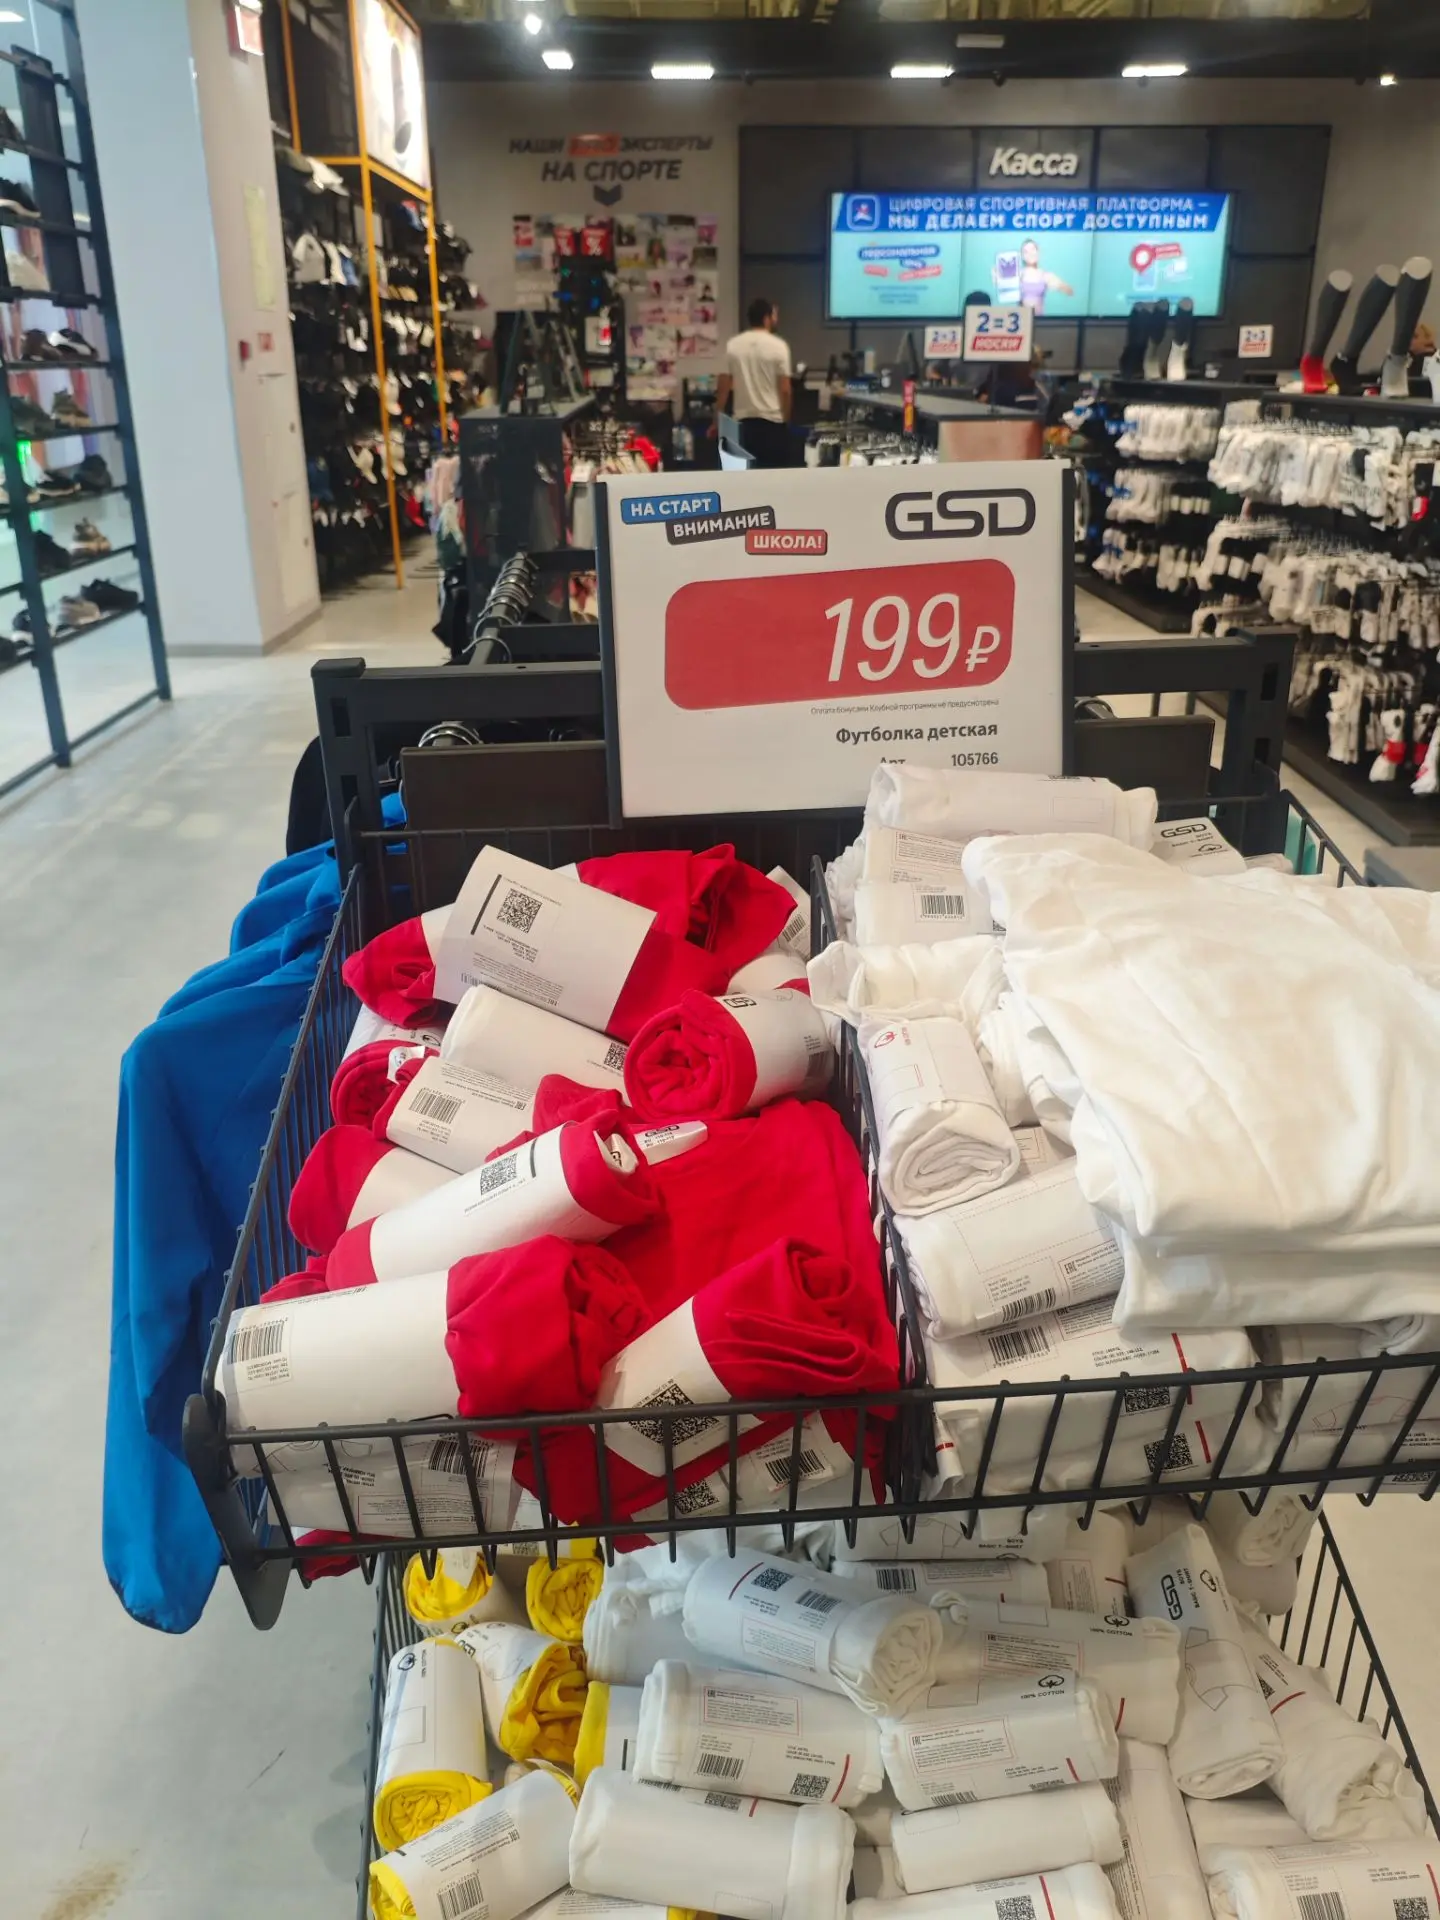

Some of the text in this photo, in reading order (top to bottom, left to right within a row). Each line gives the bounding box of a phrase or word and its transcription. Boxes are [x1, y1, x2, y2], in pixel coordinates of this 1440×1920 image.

[542, 159, 682, 182] НА СПОРТЕ
[989, 147, 1078, 176] Касса
[888, 196, 976, 212] ЦИФРОВАЯ
[979, 196, 1089, 212] СПОРТИВНАЯ
[1096, 196, 1193, 212] ПЛАТФОРМА
[888, 213, 1209, 231] МЫ ДЕЛАЕМ СПОРТ ДОСТУПНЫМ
[630, 498, 712, 518] НА СТАРТ
[885, 488, 1036, 541] GSD
[673, 511, 771, 538] ВНИМАНИЕ
[753, 534, 822, 550] ШКОЛА!
[836, 724, 998, 746] Футболка детская
[951, 752, 999, 767] 105766
[1161, 823, 1207, 839] GSD
[1161, 1573, 1183, 1621] GSD
